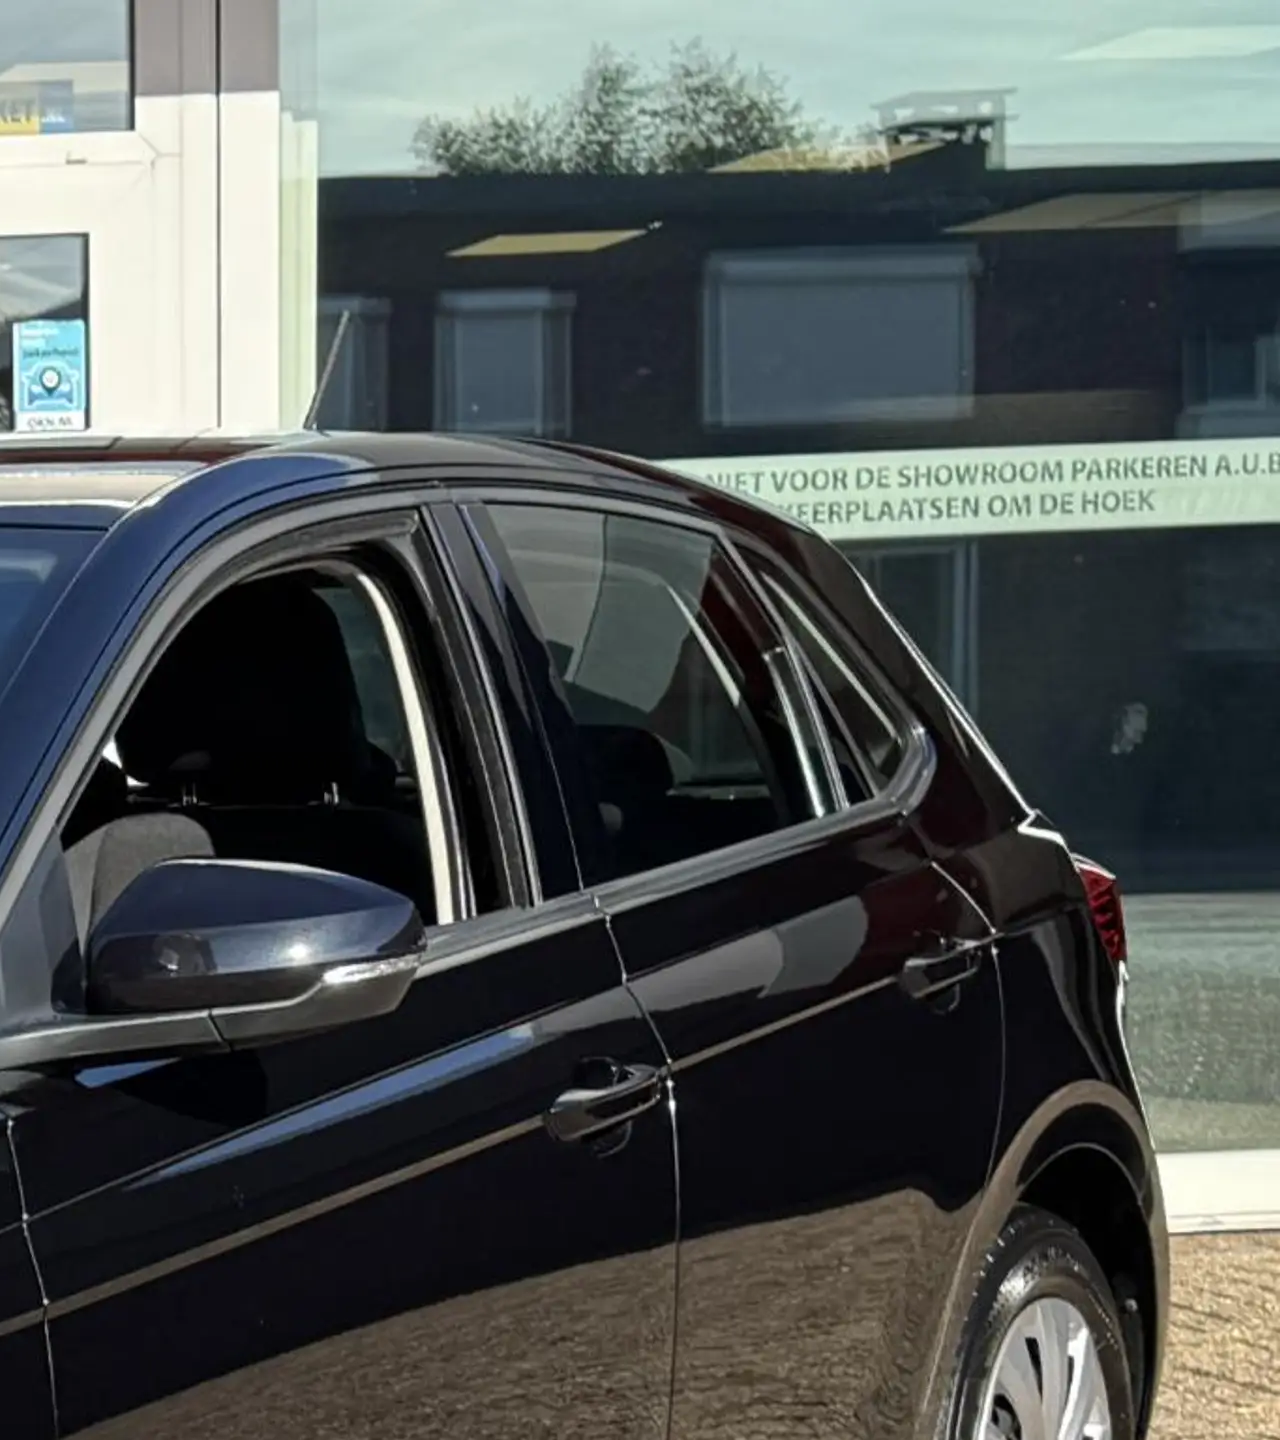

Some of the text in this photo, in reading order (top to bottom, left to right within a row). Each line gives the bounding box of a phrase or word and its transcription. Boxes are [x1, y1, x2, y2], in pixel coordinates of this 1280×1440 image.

[771, 467, 848, 493] VOOR
[856, 465, 890, 490] DE
[897, 459, 1064, 489] SHOWROOM
[1071, 455, 1207, 483] PARKEREN
[988, 494, 1032, 518] OM
[1039, 493, 1074, 515] DE
[1081, 489, 1156, 514] HOEK
